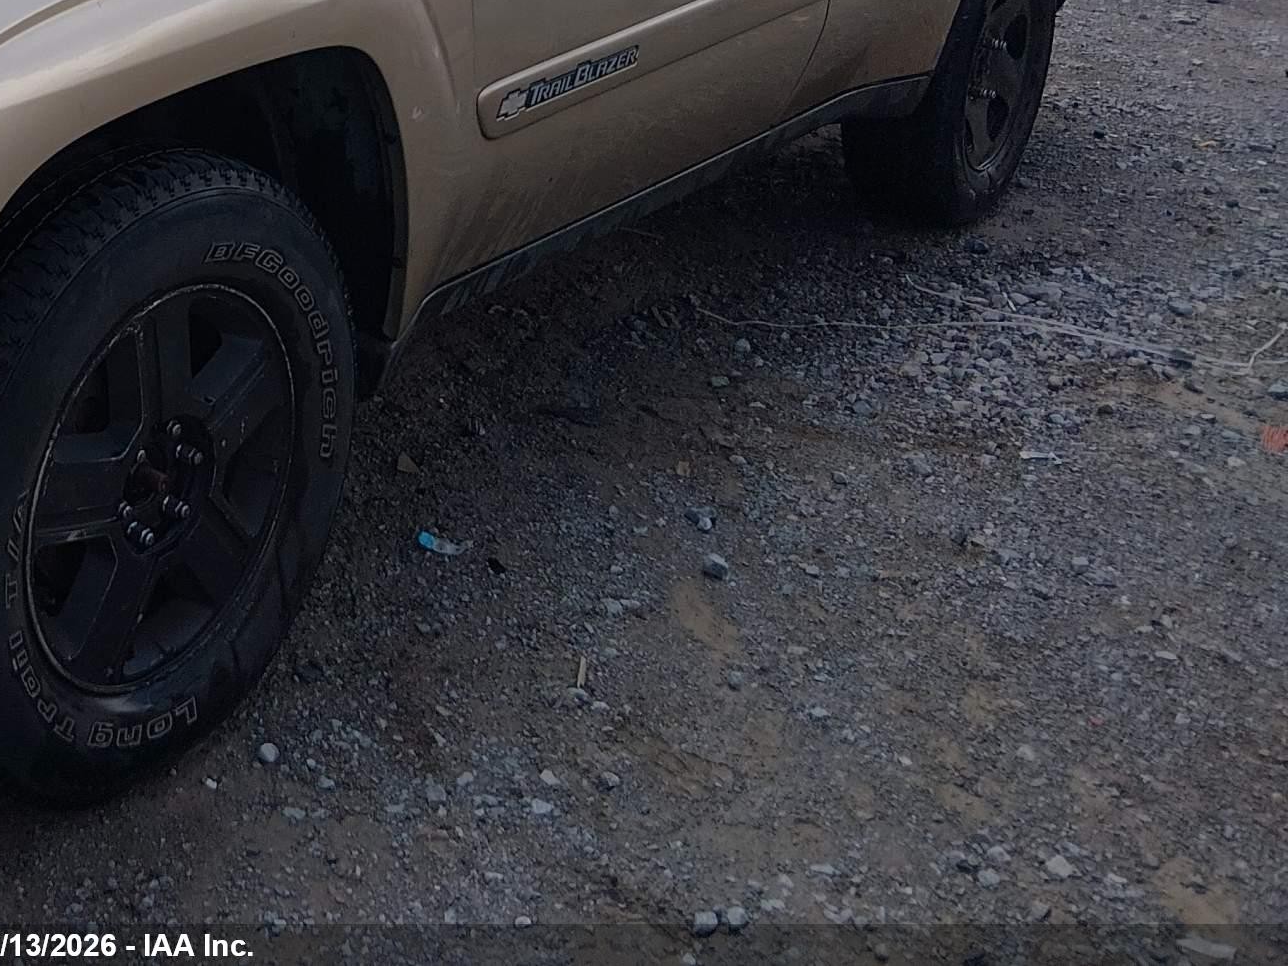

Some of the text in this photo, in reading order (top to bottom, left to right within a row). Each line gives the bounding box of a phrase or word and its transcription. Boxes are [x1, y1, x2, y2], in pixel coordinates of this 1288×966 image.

[205, 241, 337, 459] BFGoodrich
[8, 630, 76, 742] Trail
[86, 695, 198, 748] Long
